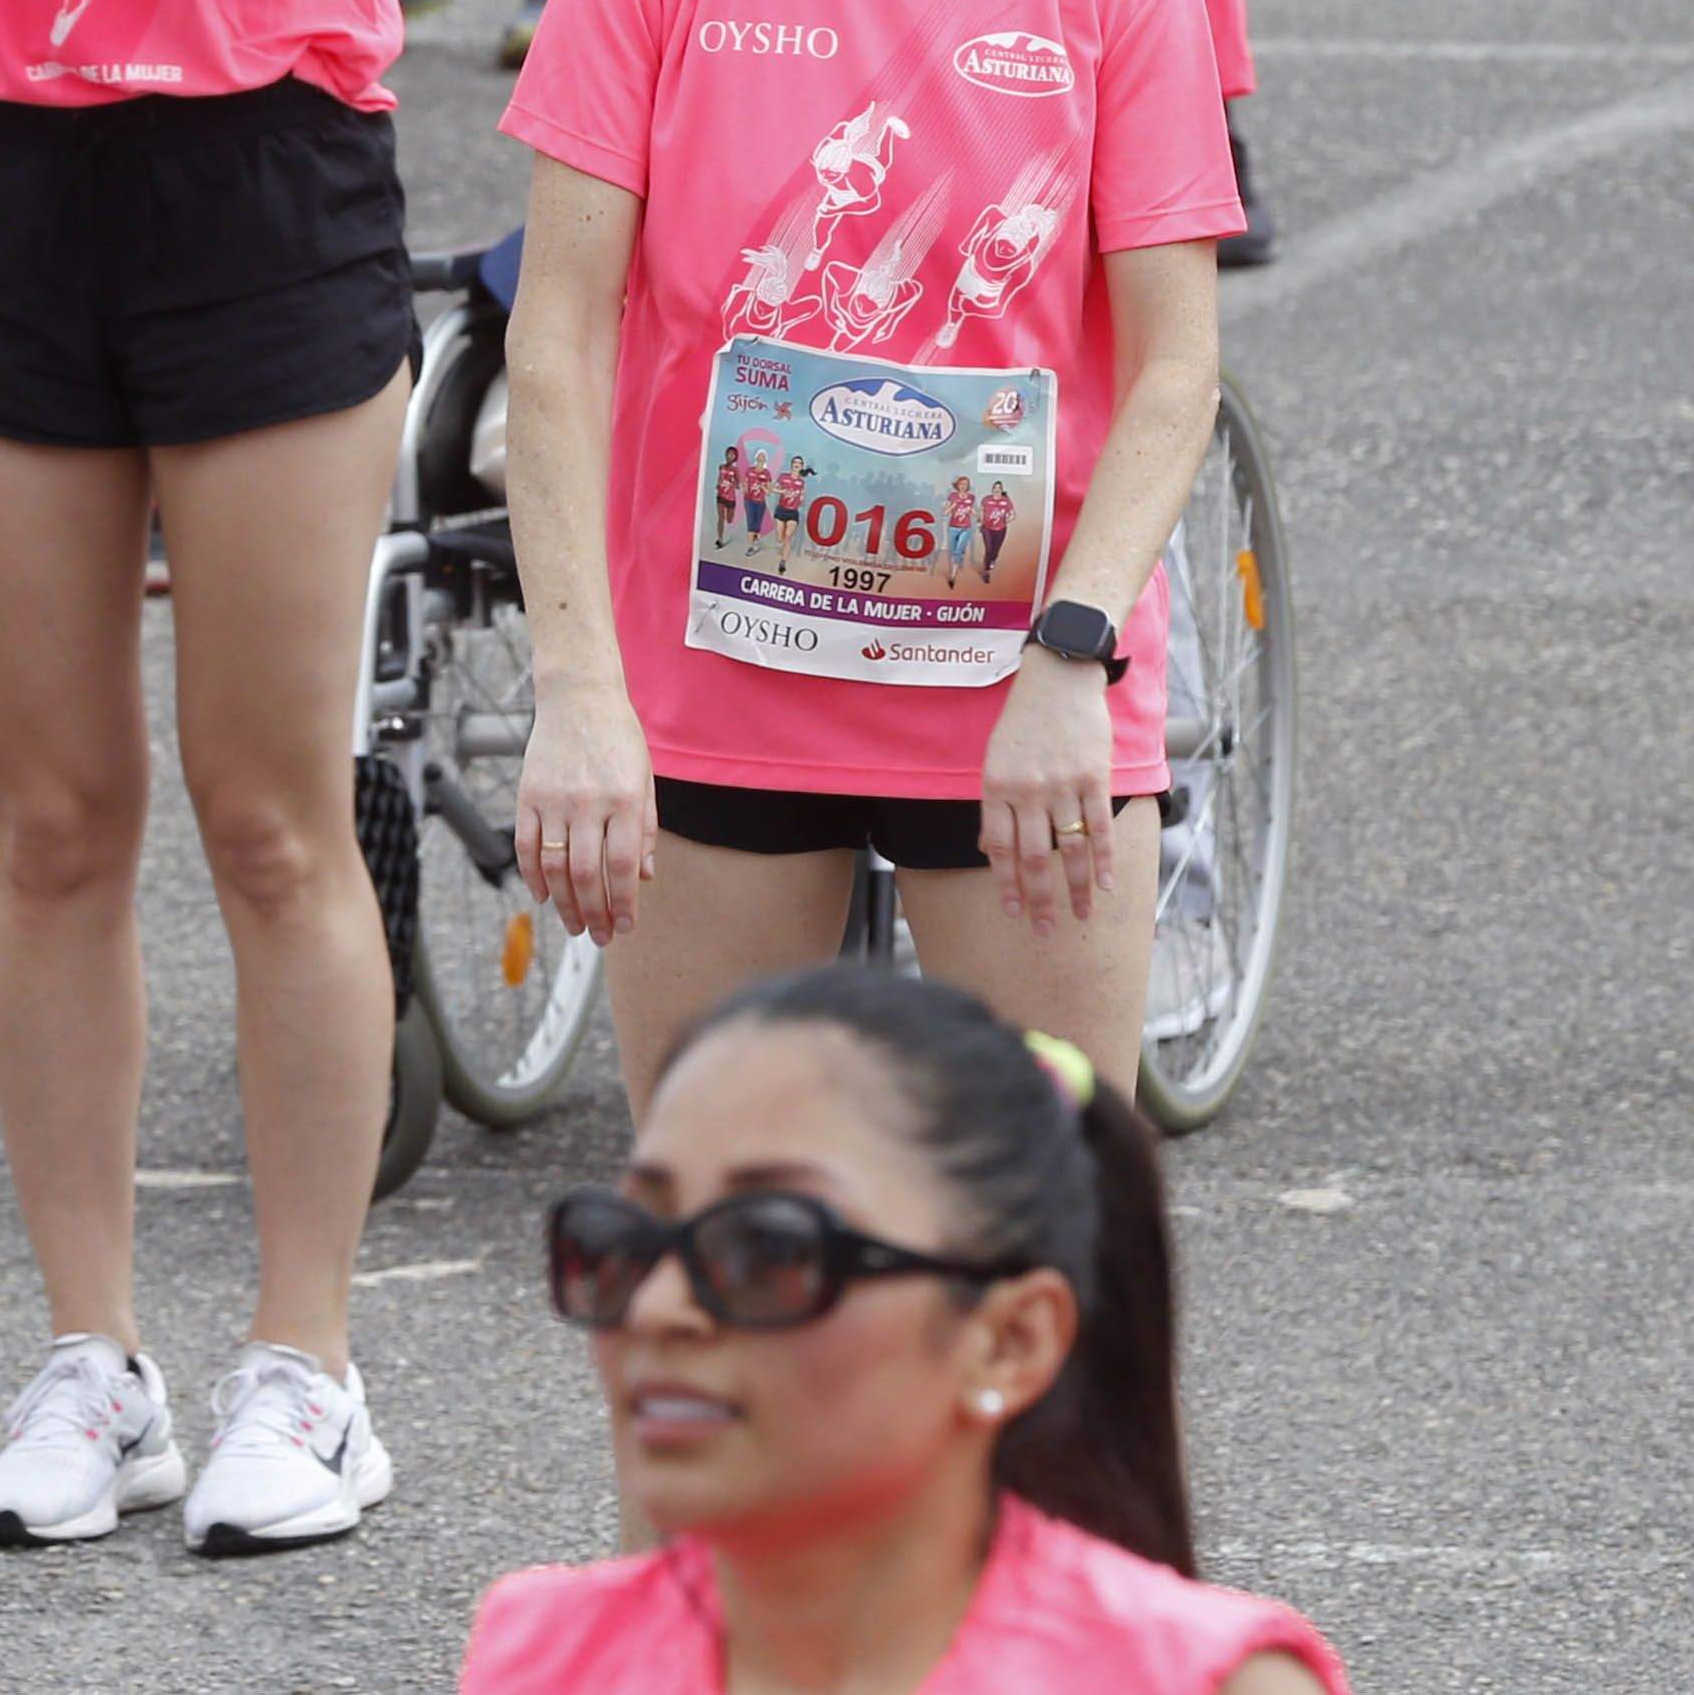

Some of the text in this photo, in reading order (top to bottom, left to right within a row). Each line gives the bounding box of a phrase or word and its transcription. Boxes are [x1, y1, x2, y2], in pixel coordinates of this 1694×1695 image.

[698, 19, 840, 60] OYSHO
[964, 48, 1070, 85] ASTURIANA
[735, 366, 791, 392] SUMA
[736, 353, 793, 376] TU DORSAL
[819, 396, 943, 441] ASTURIANA
[805, 495, 936, 561] 016
[827, 565, 892, 594] 1997
[739, 575, 986, 624] CARRERA DE LA MUJER GIJÓN
[720, 610, 819, 652] OYSHO
[888, 641, 996, 665] Santander
